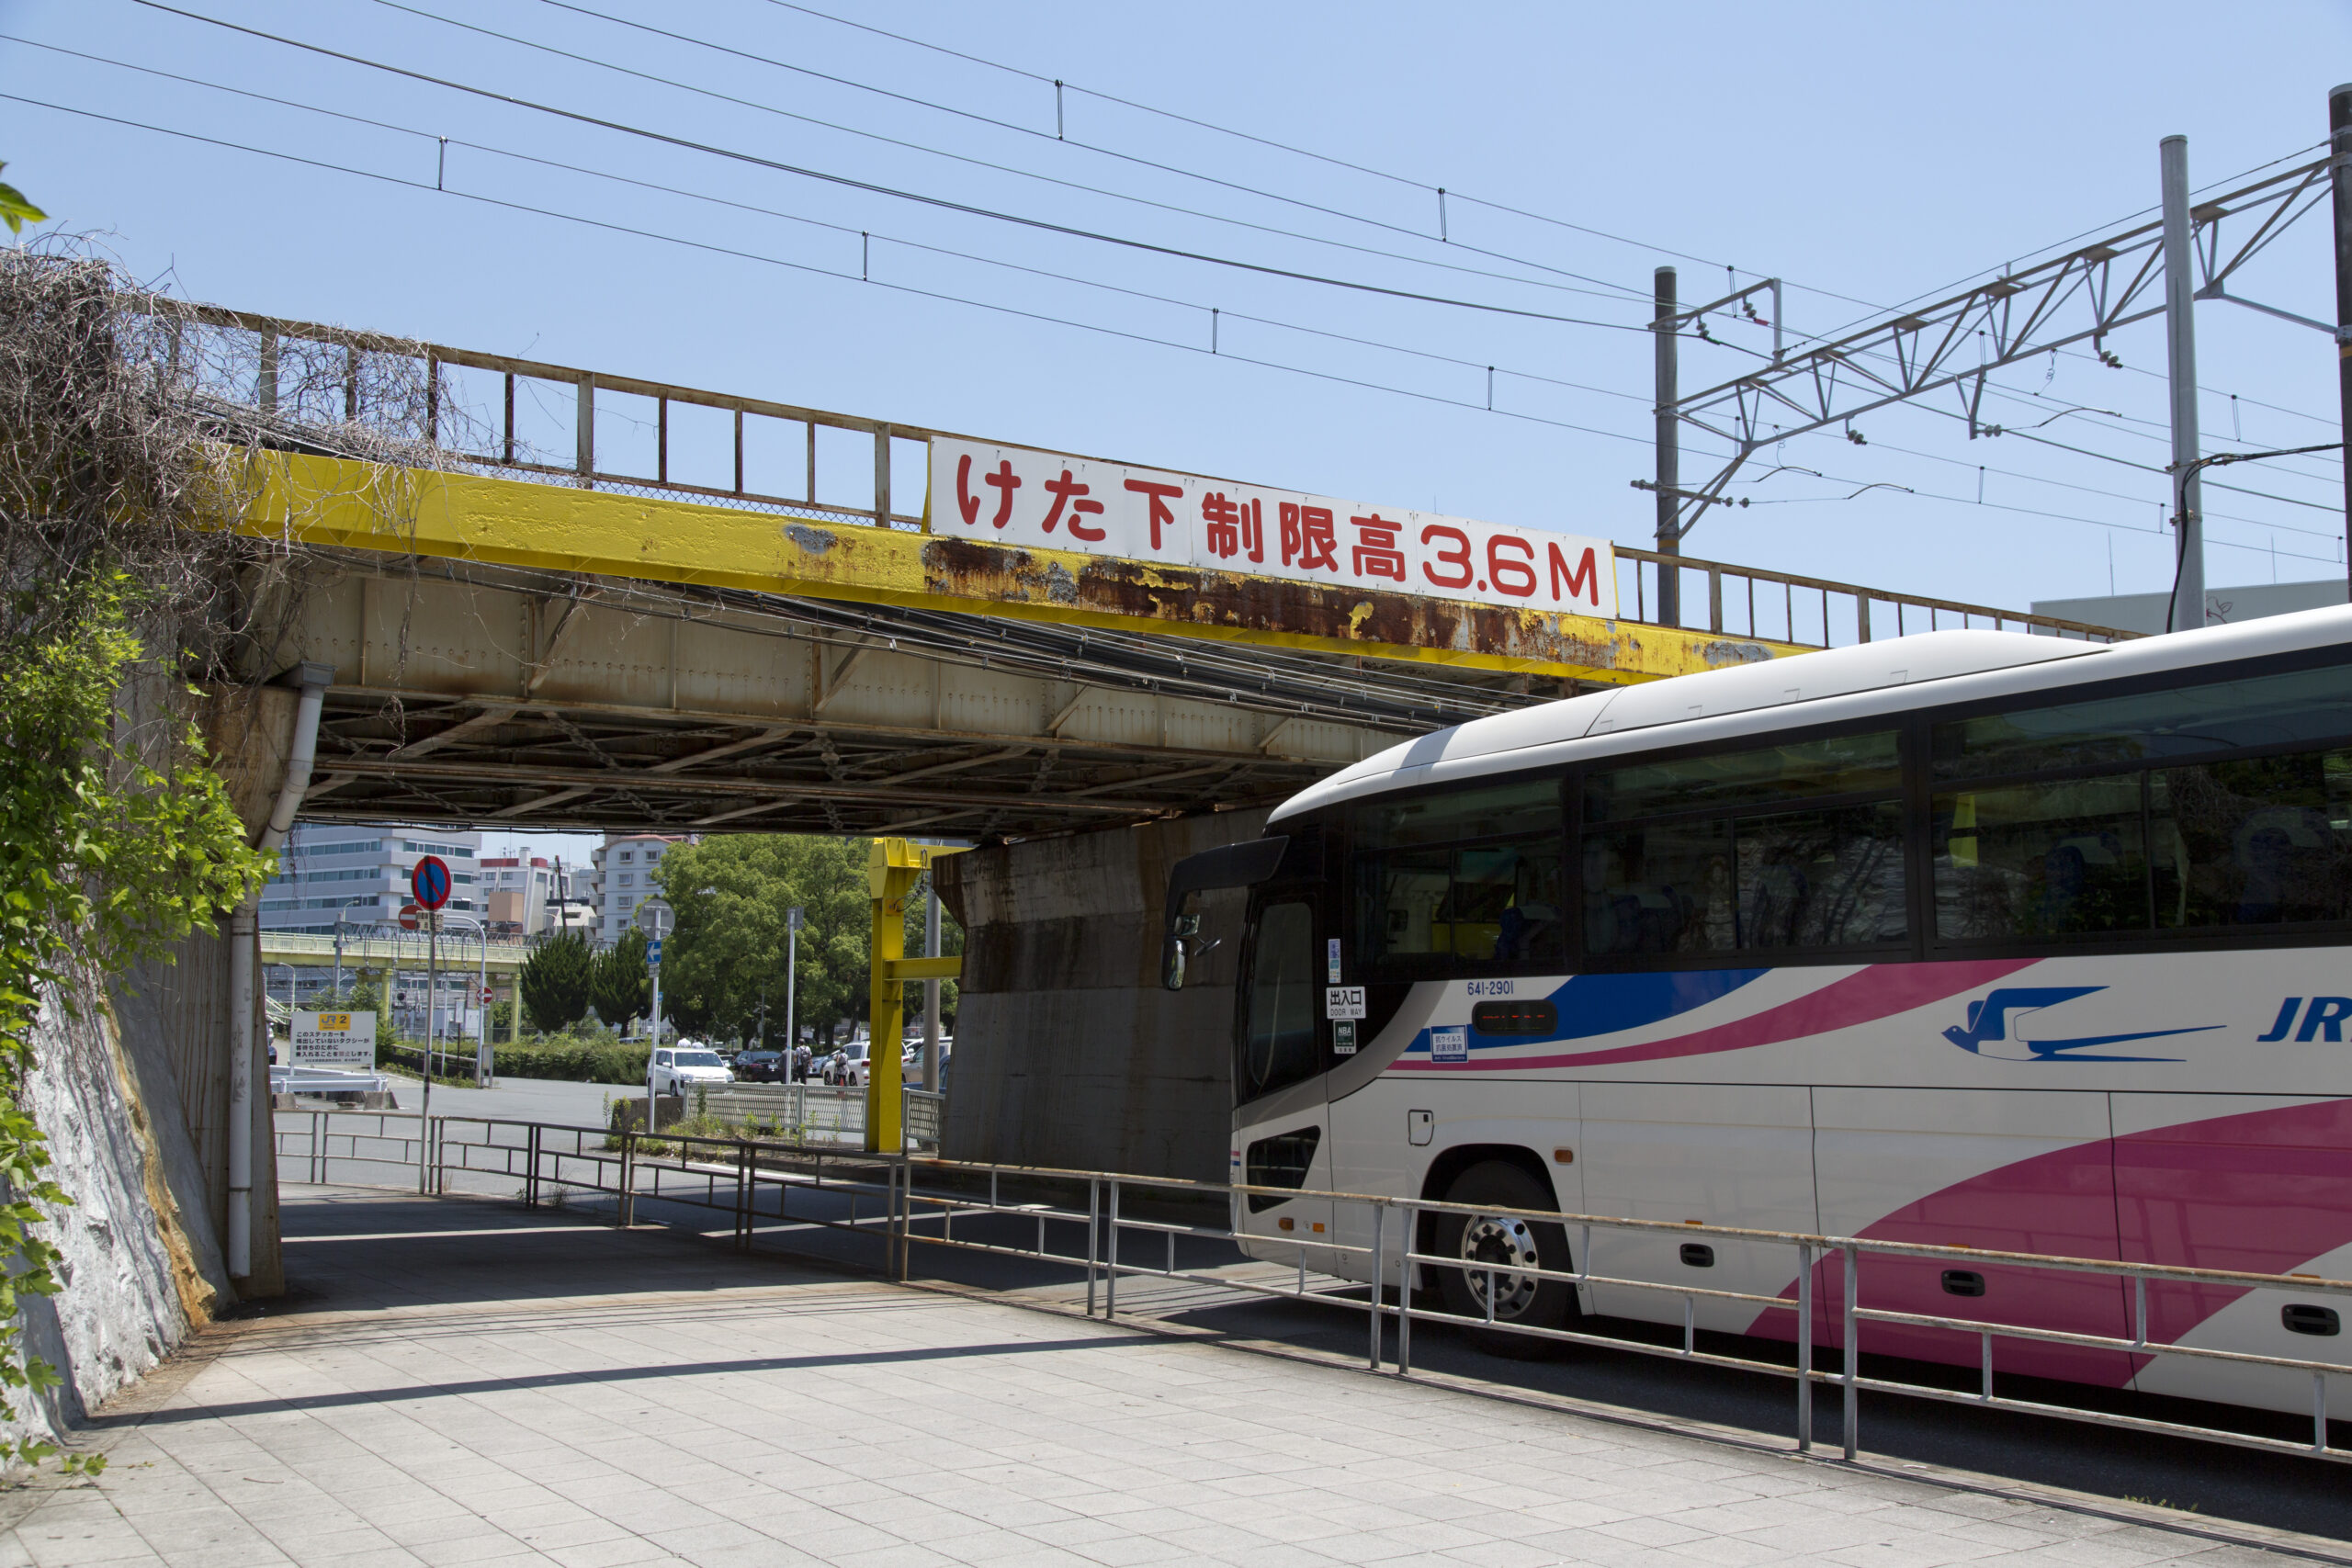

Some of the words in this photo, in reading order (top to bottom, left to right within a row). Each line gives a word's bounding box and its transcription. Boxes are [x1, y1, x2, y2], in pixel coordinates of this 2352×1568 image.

[1467, 980, 1513, 996] 641-2901
[1330, 989, 1362, 1006] 出入口
[1330, 1008, 1346, 1016] DOOR
[1351, 1008, 1363, 1016] WAY
[322, 1015, 336, 1023] JR
[339, 1015, 347, 1024] 2
[2256, 996, 2352, 1043] JR
[1338, 1026, 1351, 1035] NBA
